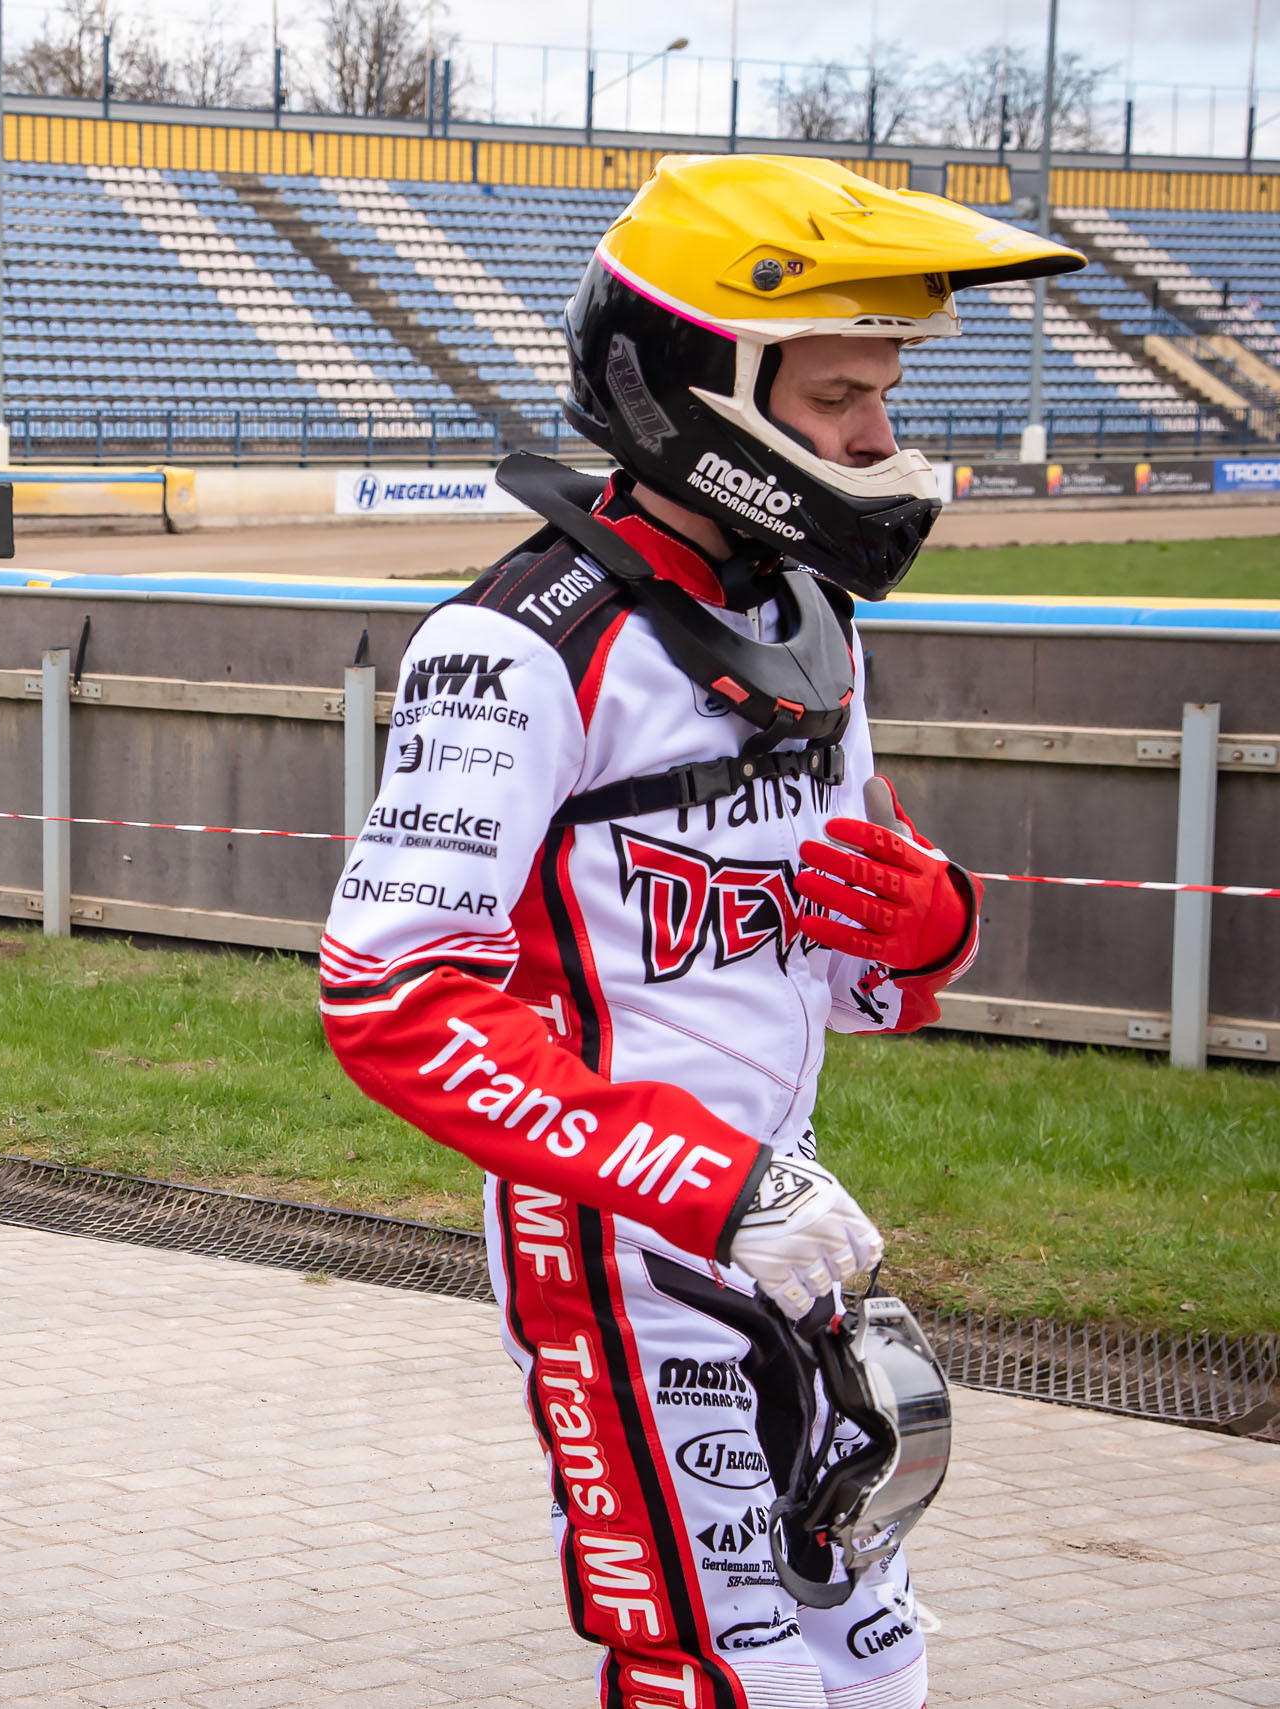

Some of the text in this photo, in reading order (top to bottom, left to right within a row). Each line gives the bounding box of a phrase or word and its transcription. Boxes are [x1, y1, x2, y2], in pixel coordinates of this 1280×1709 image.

[384, 484, 487, 500] HEGELMANN
[686, 471, 806, 543] MOTORRADSHOP
[517, 569, 594, 626] Trans
[437, 744, 515, 777] PIPP
[406, 835, 433, 848] DEIN
[435, 838, 498, 858] AUTOHAUS
[418, 1017, 599, 1158] Trans
[598, 1121, 733, 1205] MF
[512, 1184, 572, 1283] MF
[540, 1335, 618, 1517] Trans
[656, 1391, 753, 1413] MOTORRAD-SHOP
[695, 1442, 726, 1477] LJ
[578, 1535, 663, 1639] MF
[702, 1557, 760, 1573] Gerdemann
